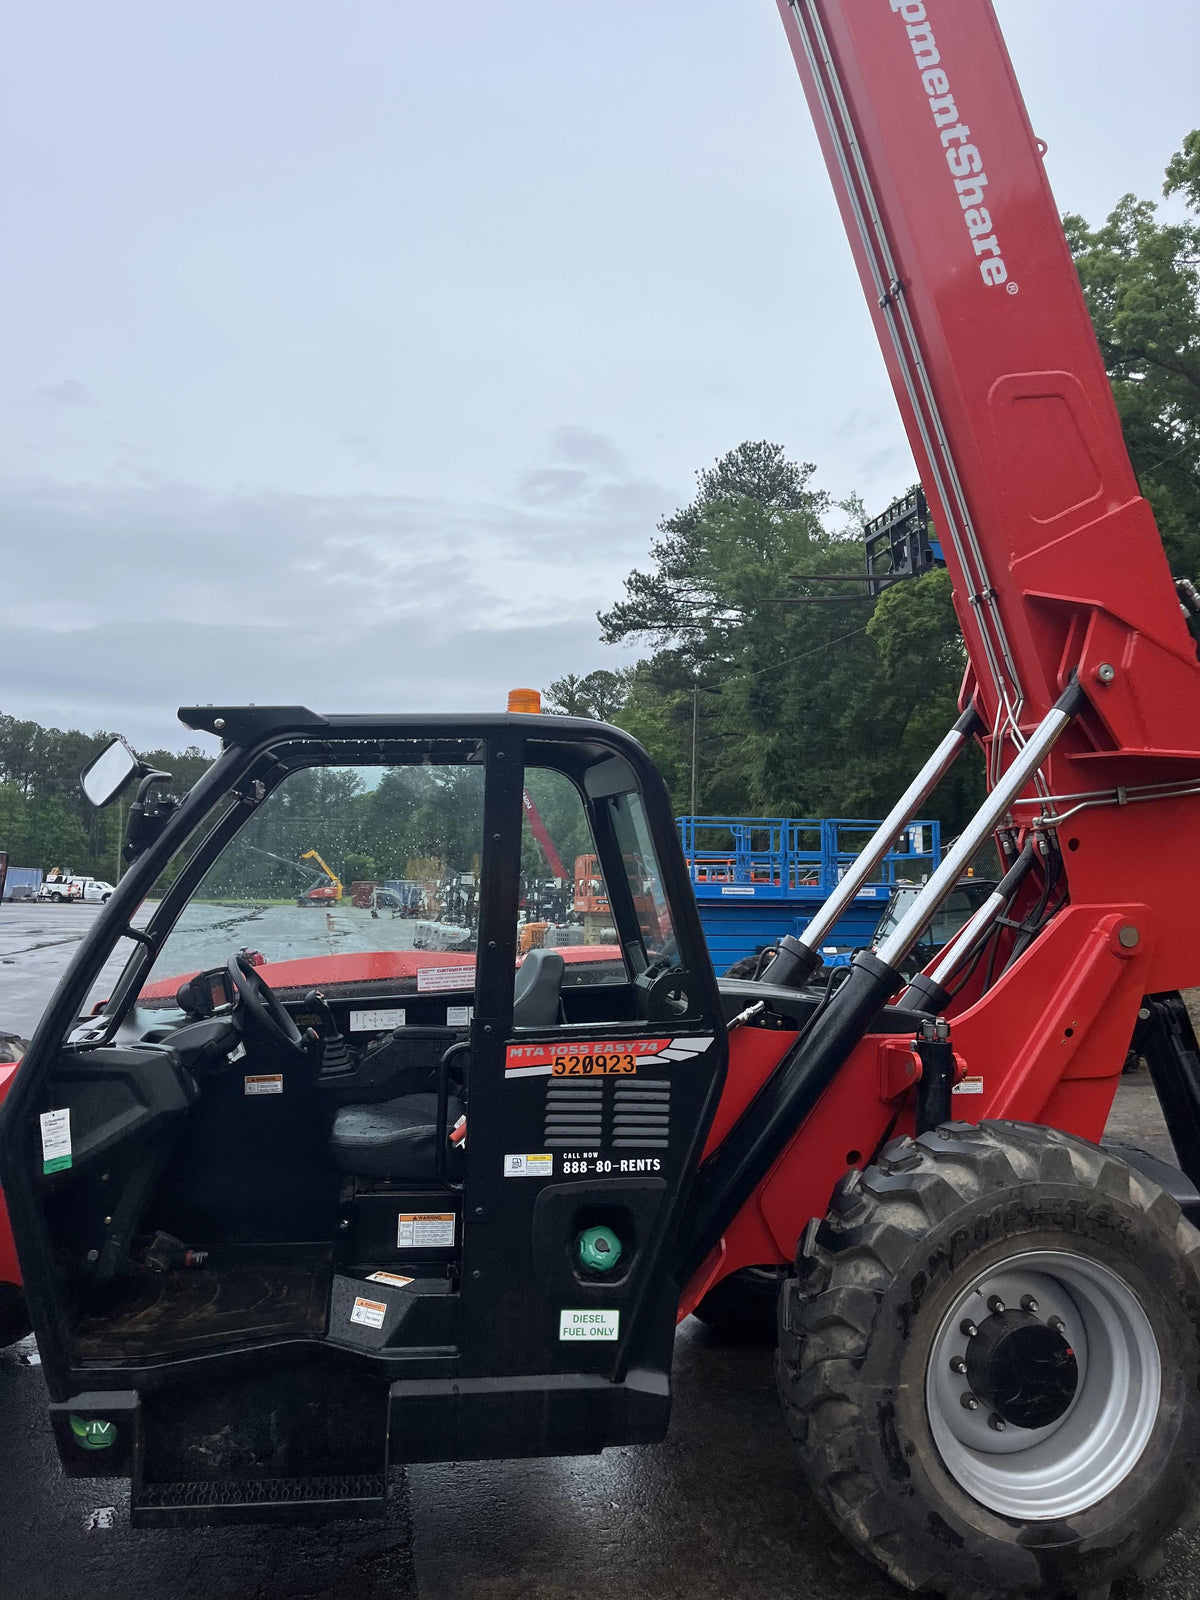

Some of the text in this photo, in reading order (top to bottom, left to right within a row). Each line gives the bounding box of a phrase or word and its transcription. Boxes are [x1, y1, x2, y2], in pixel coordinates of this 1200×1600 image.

[510, 1042, 658, 1057] MTA 1055 EASY 74
[554, 1055, 635, 1075] 520923
[563, 1158, 661, 1174] 888-80-RENTS
[572, 1314, 607, 1324] DIESEL
[563, 1327, 615, 1336] FUEL ONLY
